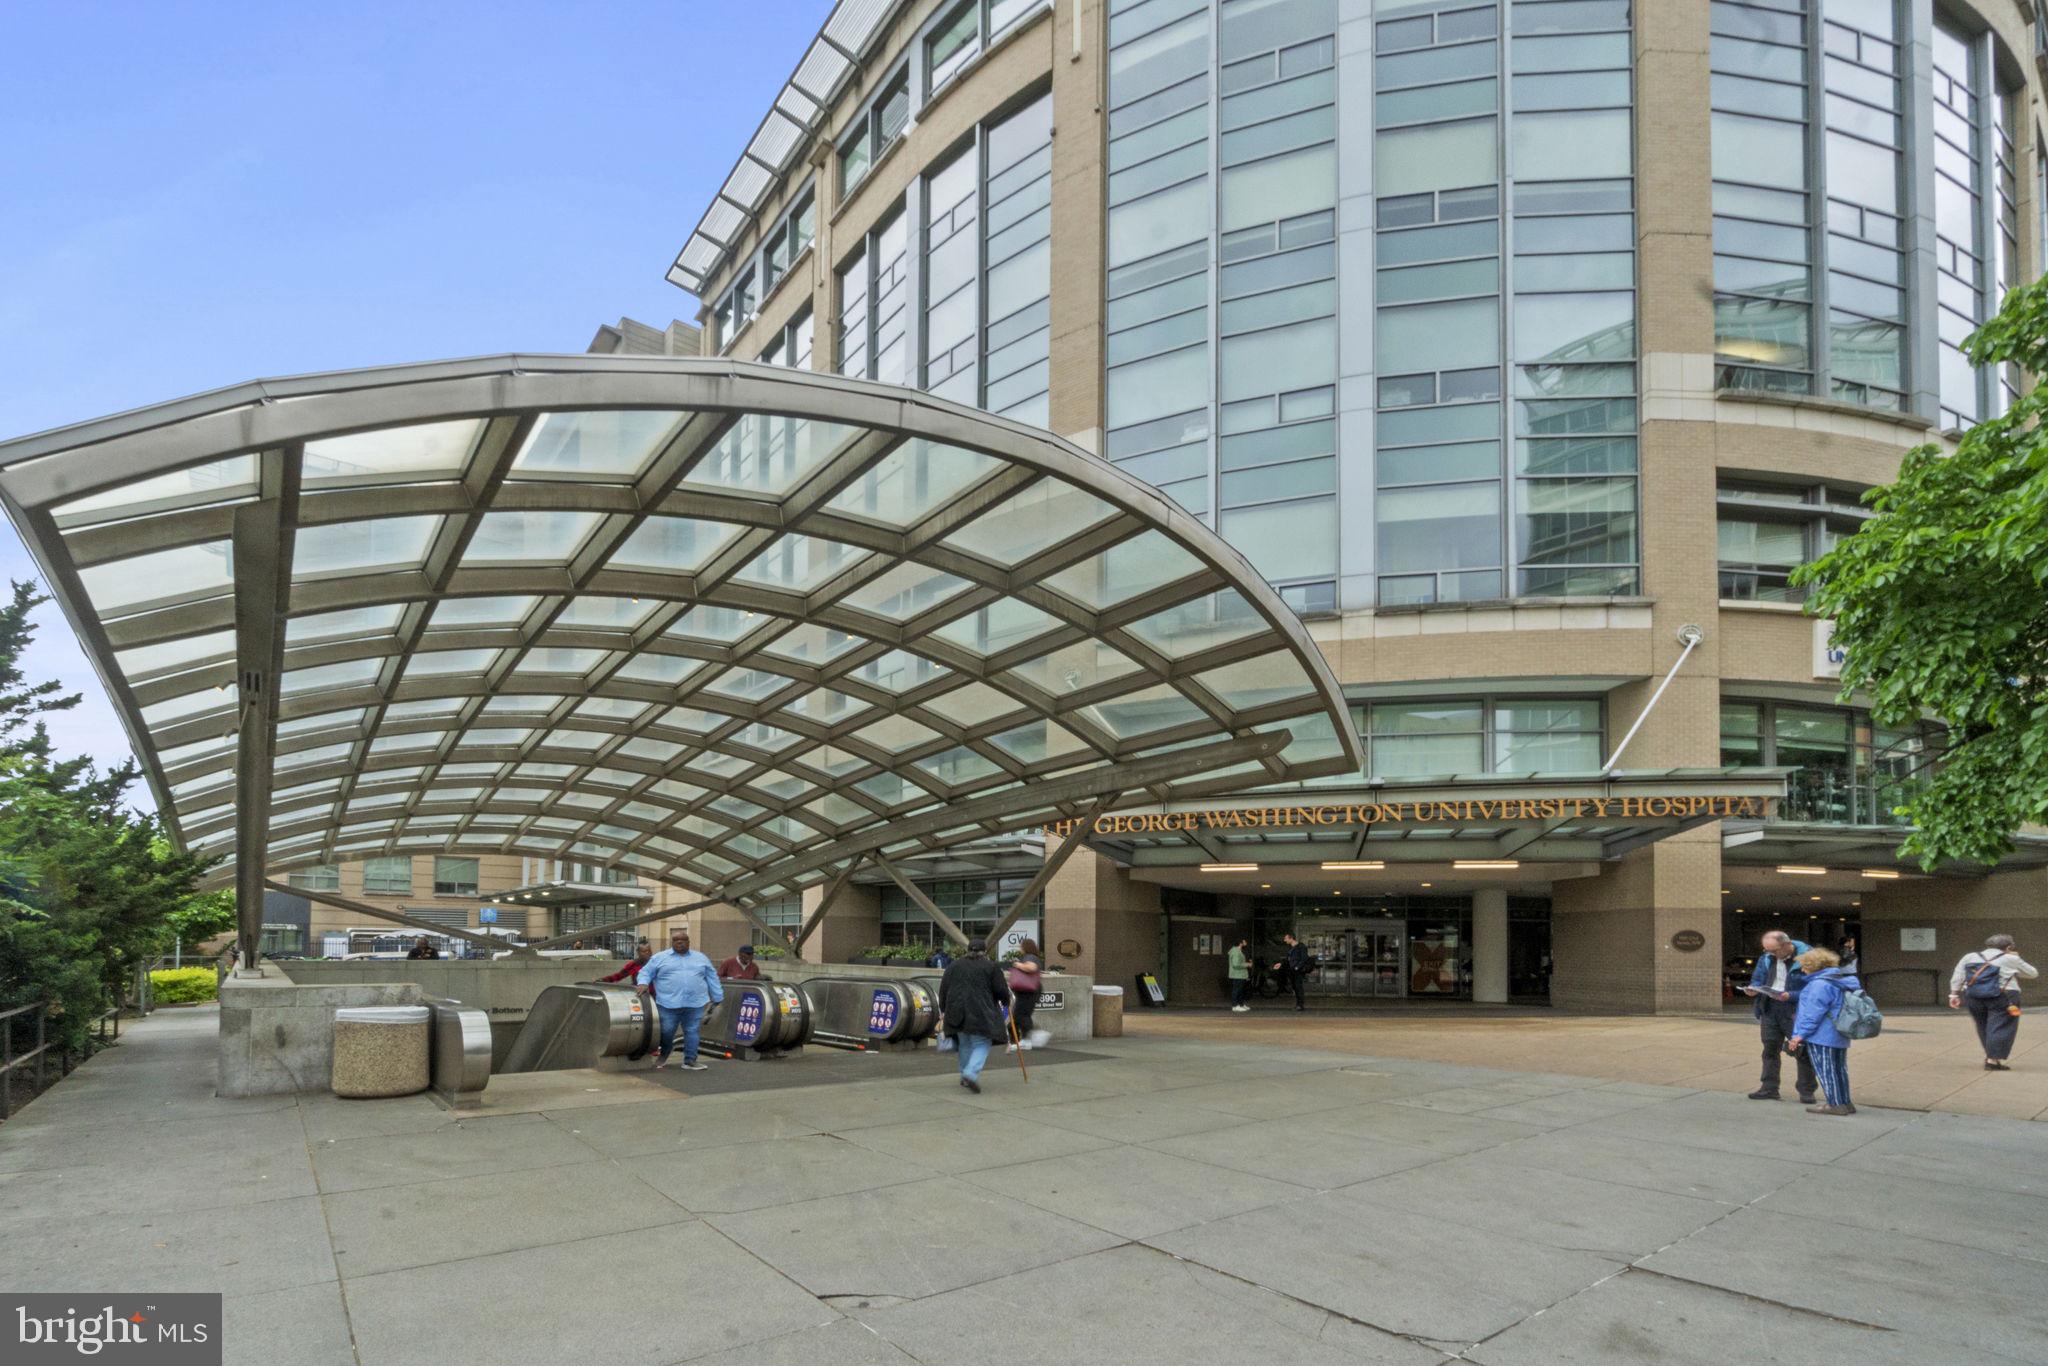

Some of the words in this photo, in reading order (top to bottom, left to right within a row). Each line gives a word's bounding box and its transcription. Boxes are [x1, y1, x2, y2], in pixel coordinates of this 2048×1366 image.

[1094, 812, 1199, 834] GEORGE
[1204, 803, 1403, 829] WASHINGTON
[1414, 797, 1612, 821] UNIVERSITY
